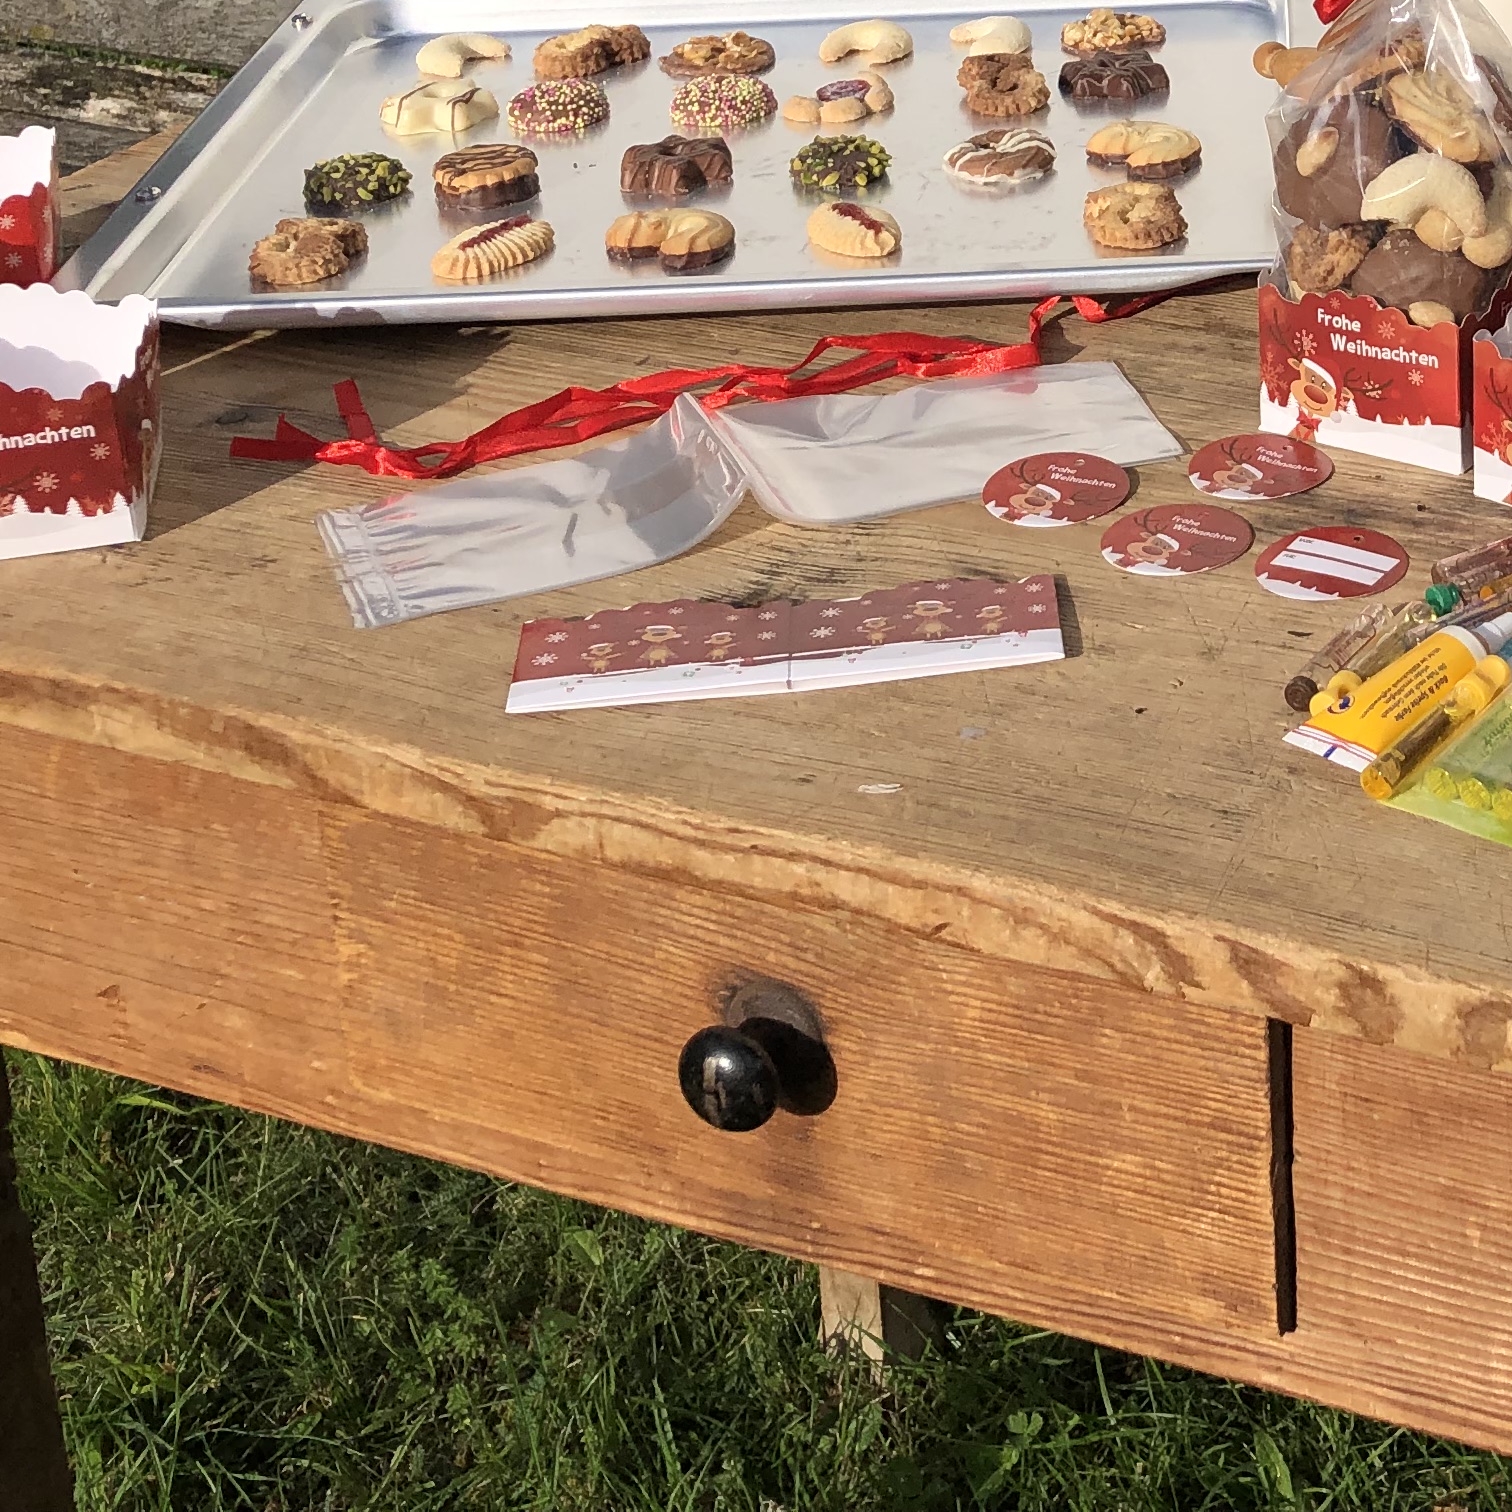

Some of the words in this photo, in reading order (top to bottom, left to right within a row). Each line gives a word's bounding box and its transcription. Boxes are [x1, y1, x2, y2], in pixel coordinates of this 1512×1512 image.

[1317, 308, 1361, 333] Frohe
[1330, 333, 1439, 369] Weihnachten
[0, 424, 96, 451] hnachten
[1256, 446, 1284, 459] Frohe
[1047, 464, 1078, 475] Frohe
[1256, 454, 1319, 473] Weihnachten
[1050, 472, 1117, 489] Weihnachten
[1171, 515, 1201, 527] Frohe
[1172, 523, 1237, 543] Weihnachten
